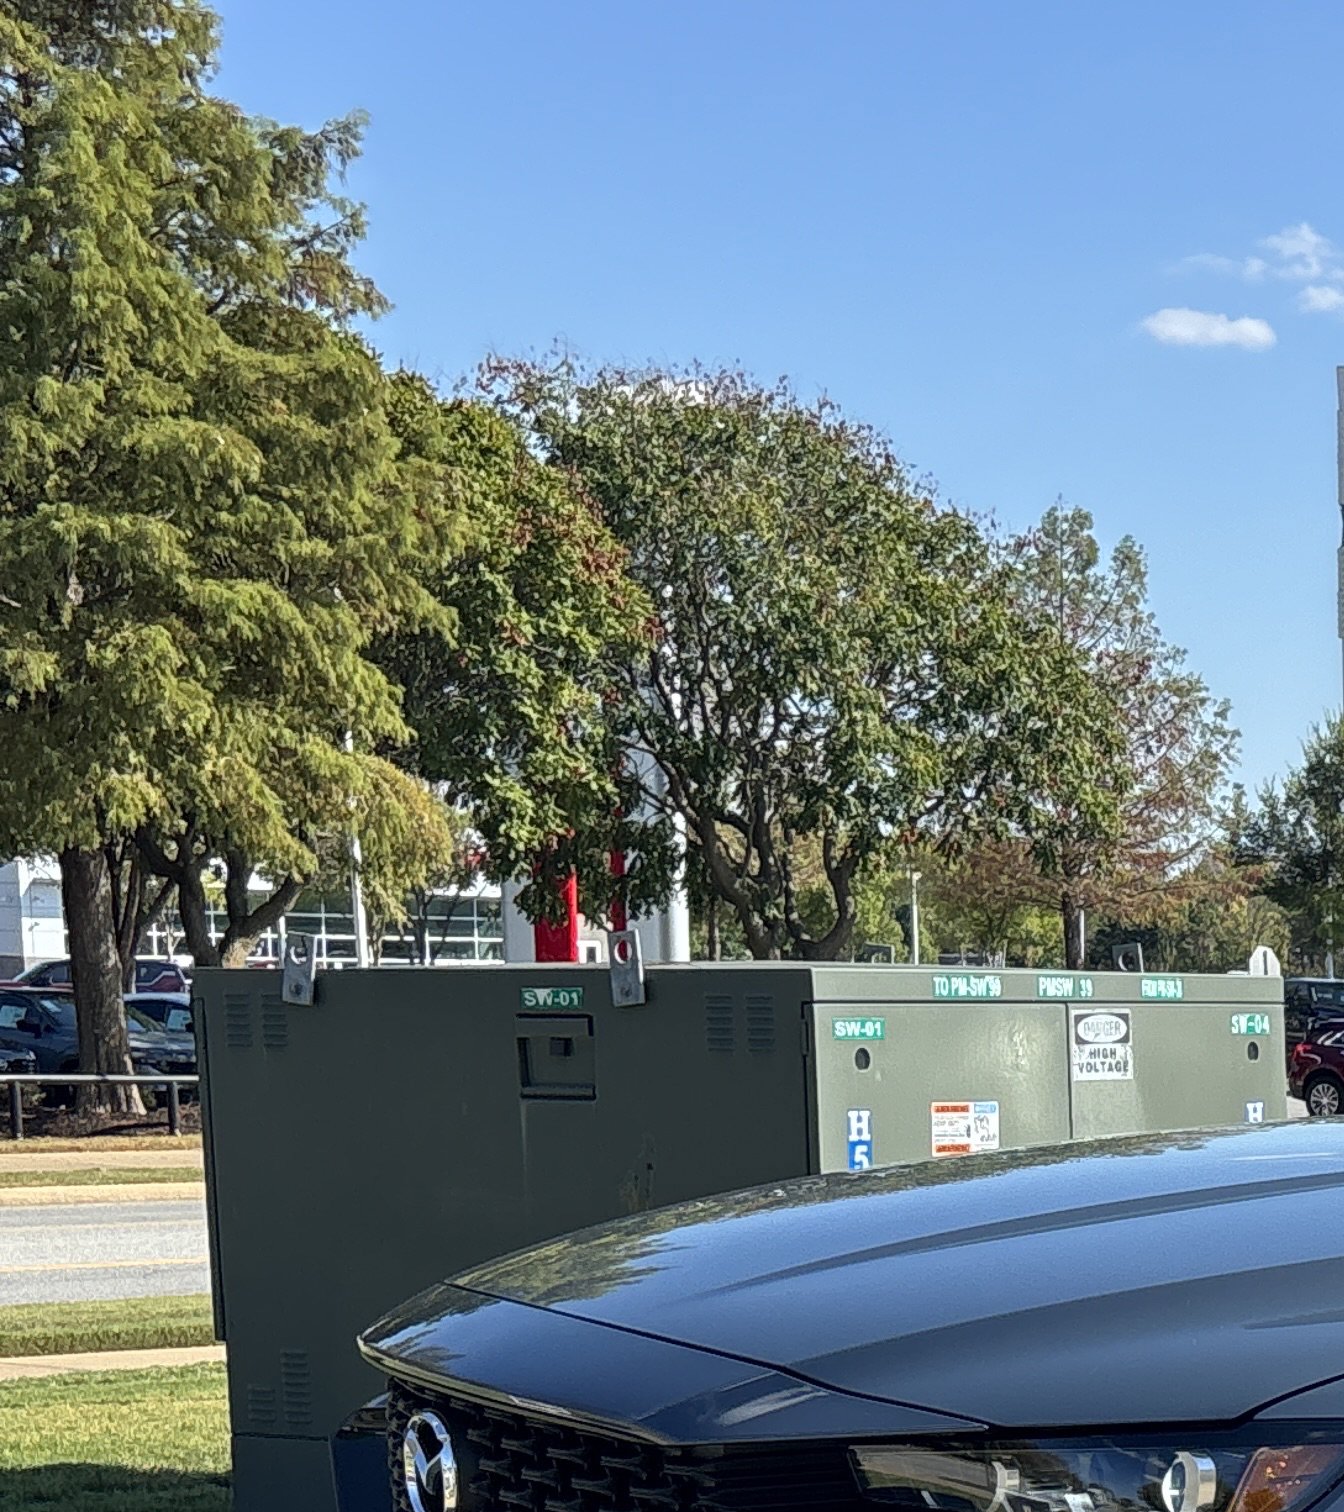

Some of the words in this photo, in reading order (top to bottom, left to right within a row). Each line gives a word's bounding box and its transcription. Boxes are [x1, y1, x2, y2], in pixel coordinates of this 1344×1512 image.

[932, 976, 949, 996] TO
[524, 990, 580, 1007] SW-01
[834, 1021, 882, 1037] SW-01
[1231, 1014, 1270, 1035] SW-04
[1089, 1047, 1117, 1060] HIGH
[1078, 1060, 1129, 1074] VOLTAGE
[1246, 1101, 1263, 1123] H
[847, 1110, 871, 1142] H
[853, 1144, 870, 1170] 5
